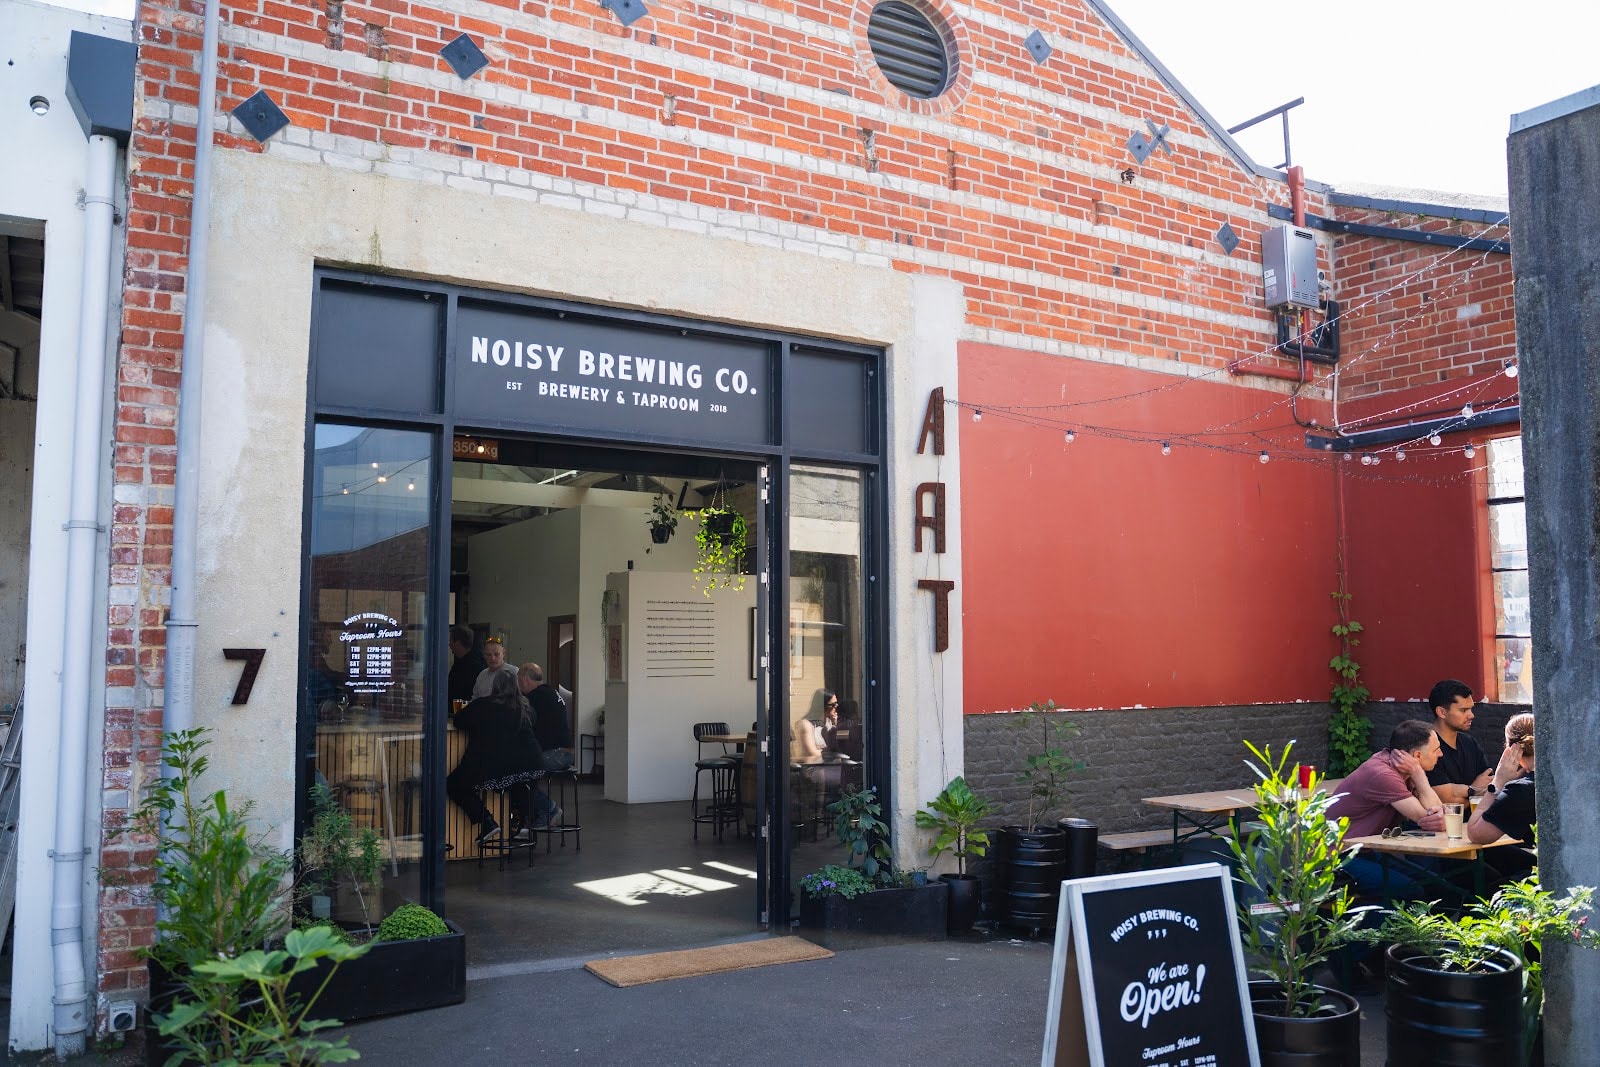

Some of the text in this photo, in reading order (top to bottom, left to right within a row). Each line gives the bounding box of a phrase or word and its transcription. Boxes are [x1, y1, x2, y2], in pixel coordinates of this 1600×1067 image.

[471, 336, 757, 395] NOISY BREWING CO.
[506, 381, 728, 413] EST BREWERY & TAPROOM 2018
[340, 629, 402, 642] Taproom Hours
[344, 614, 362, 626] NOISY
[362, 613, 388, 621] BREWING
[222, 648, 267, 705] 7
[1110, 909, 1200, 943] NOISY BREWING CO.
[1147, 962, 1190, 984] We are
[1119, 963, 1206, 1029] Open!
[1142, 1035, 1201, 1060] Taproom Hours
